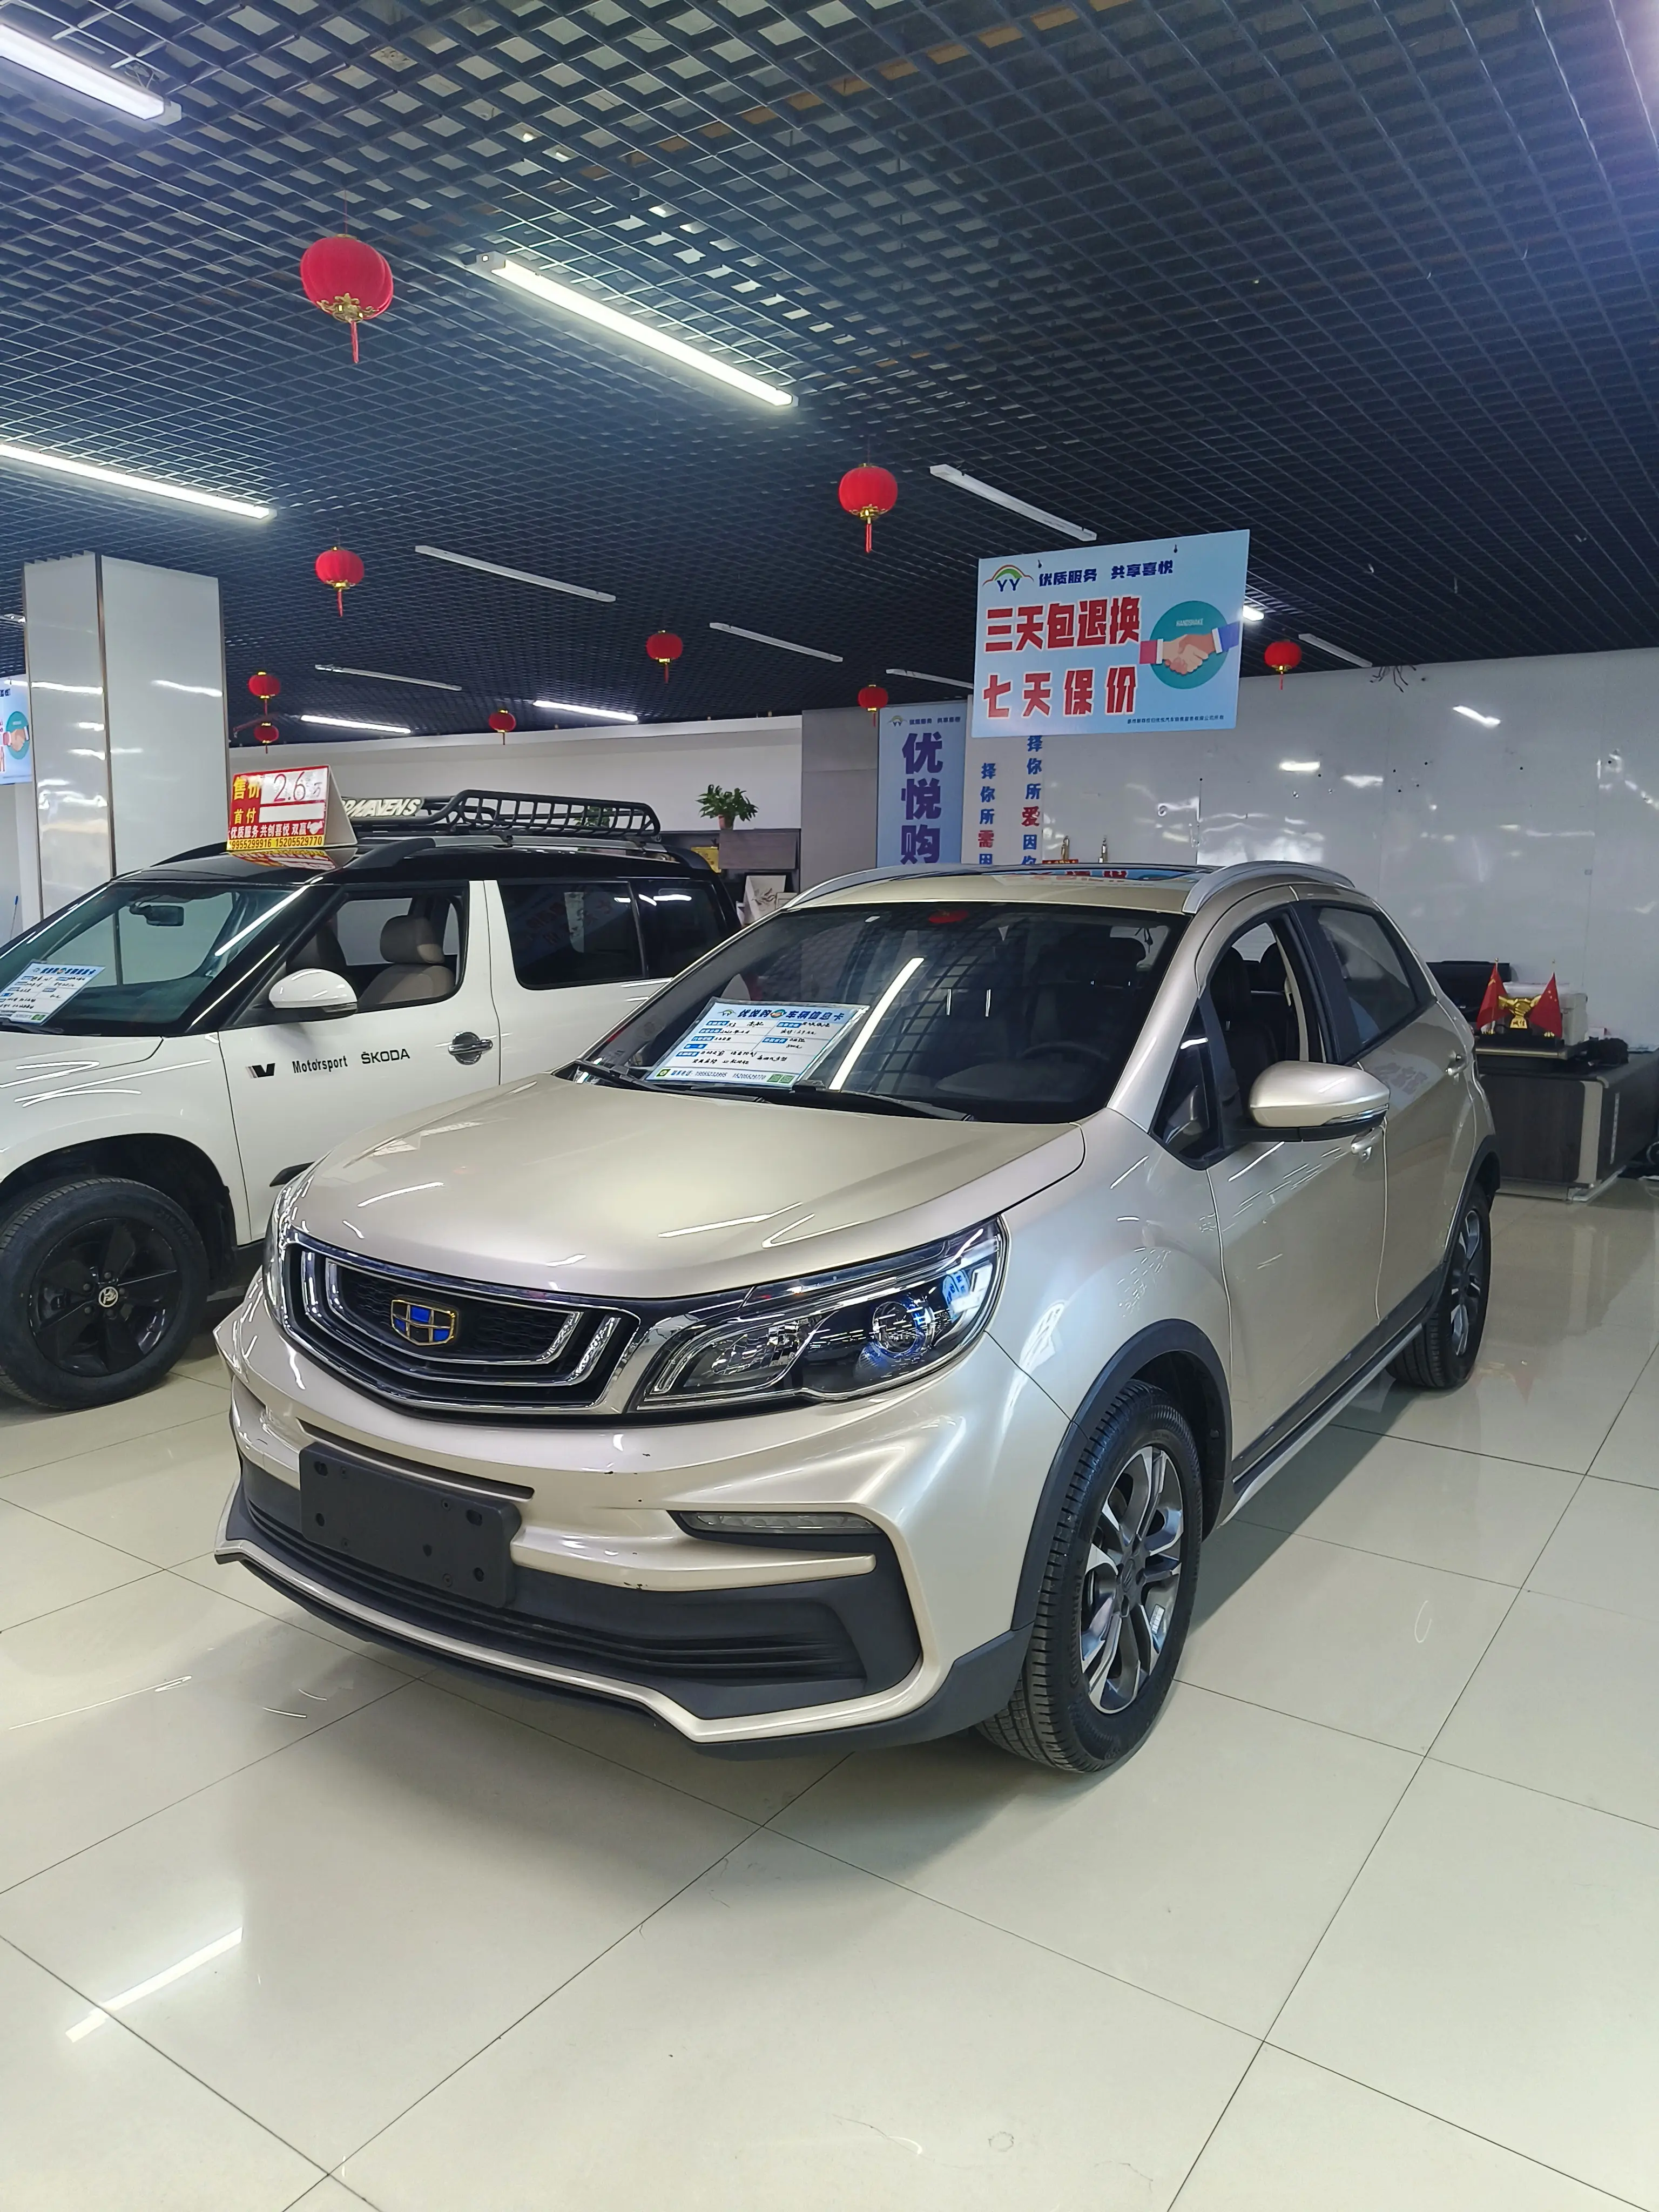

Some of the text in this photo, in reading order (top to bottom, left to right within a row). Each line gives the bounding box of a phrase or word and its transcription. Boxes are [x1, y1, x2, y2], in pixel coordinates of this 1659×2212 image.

[1039, 560, 1173, 586] 优质服务 共享喜悦
[985, 596, 1140, 652] 三天包退换
[983, 666, 1137, 718] 七天保价
[233, 775, 260, 800] 售价
[274, 771, 306, 802] 2.6
[900, 731, 943, 865] 优悦购
[234, 807, 257, 825] 首付
[231, 825, 259, 839] 优质服务
[260, 823, 290, 837] 共创喜悦
[275, 836, 322, 847] 15205529770
[292, 1055, 348, 1074] Motorsport
[361, 1048, 410, 1064] ŠKODA
